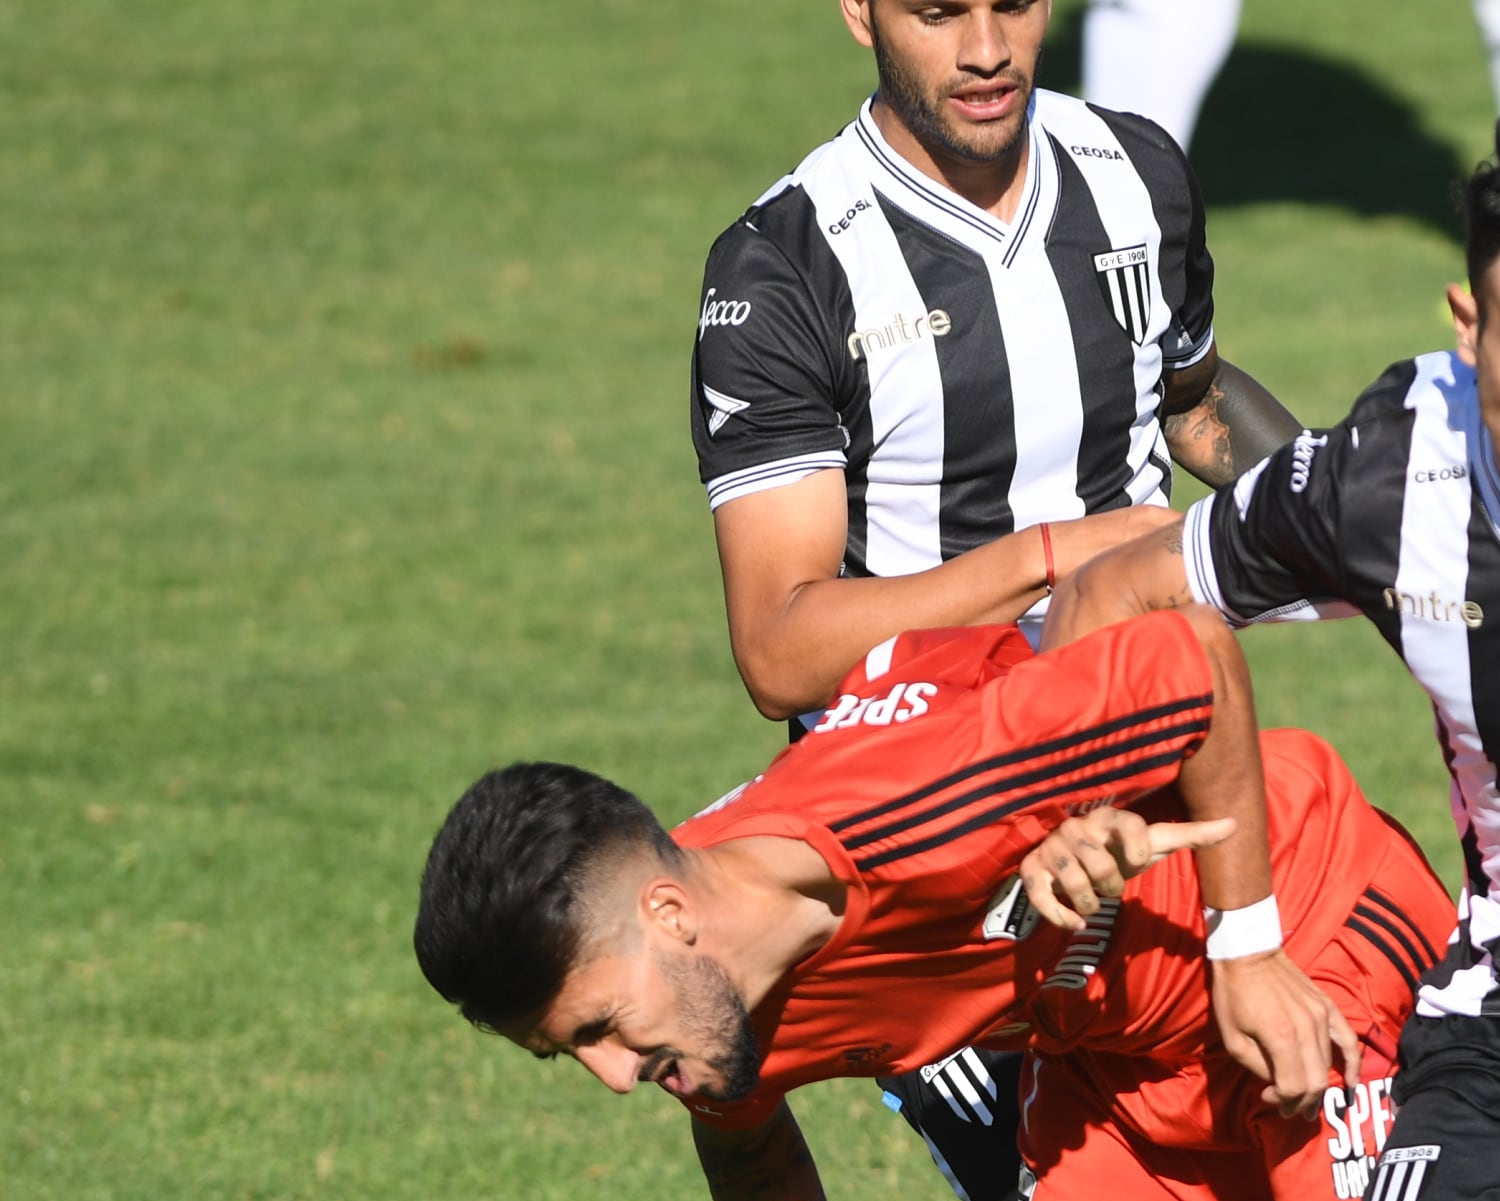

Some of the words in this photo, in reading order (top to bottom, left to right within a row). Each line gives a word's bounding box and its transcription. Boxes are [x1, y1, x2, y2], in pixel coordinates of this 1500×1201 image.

[1070, 145, 1124, 161] CEOSA
[847, 308, 952, 360] mitre
[1383, 587, 1484, 628] mitre
